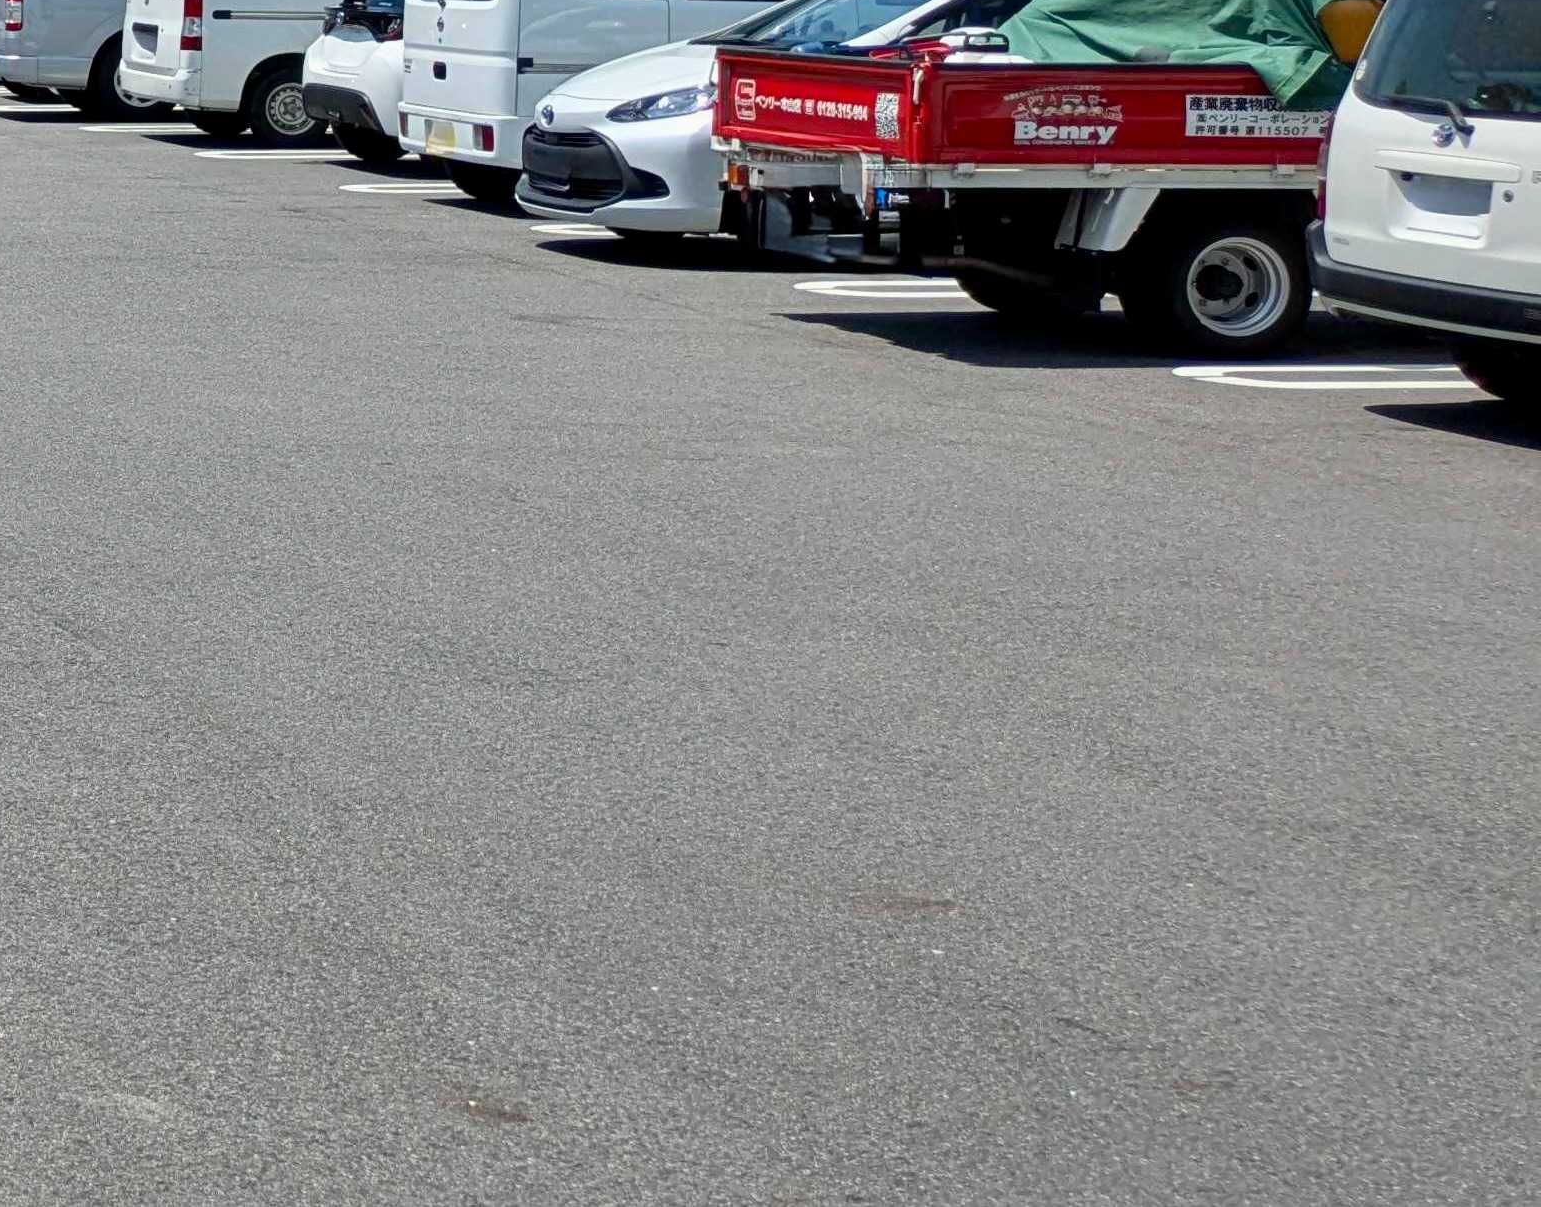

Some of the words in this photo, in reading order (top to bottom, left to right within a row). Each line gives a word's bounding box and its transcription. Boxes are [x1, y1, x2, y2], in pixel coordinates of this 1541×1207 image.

[1189, 96, 1283, 111] 産業廃棄物収
[1014, 121, 1117, 145] Benry
